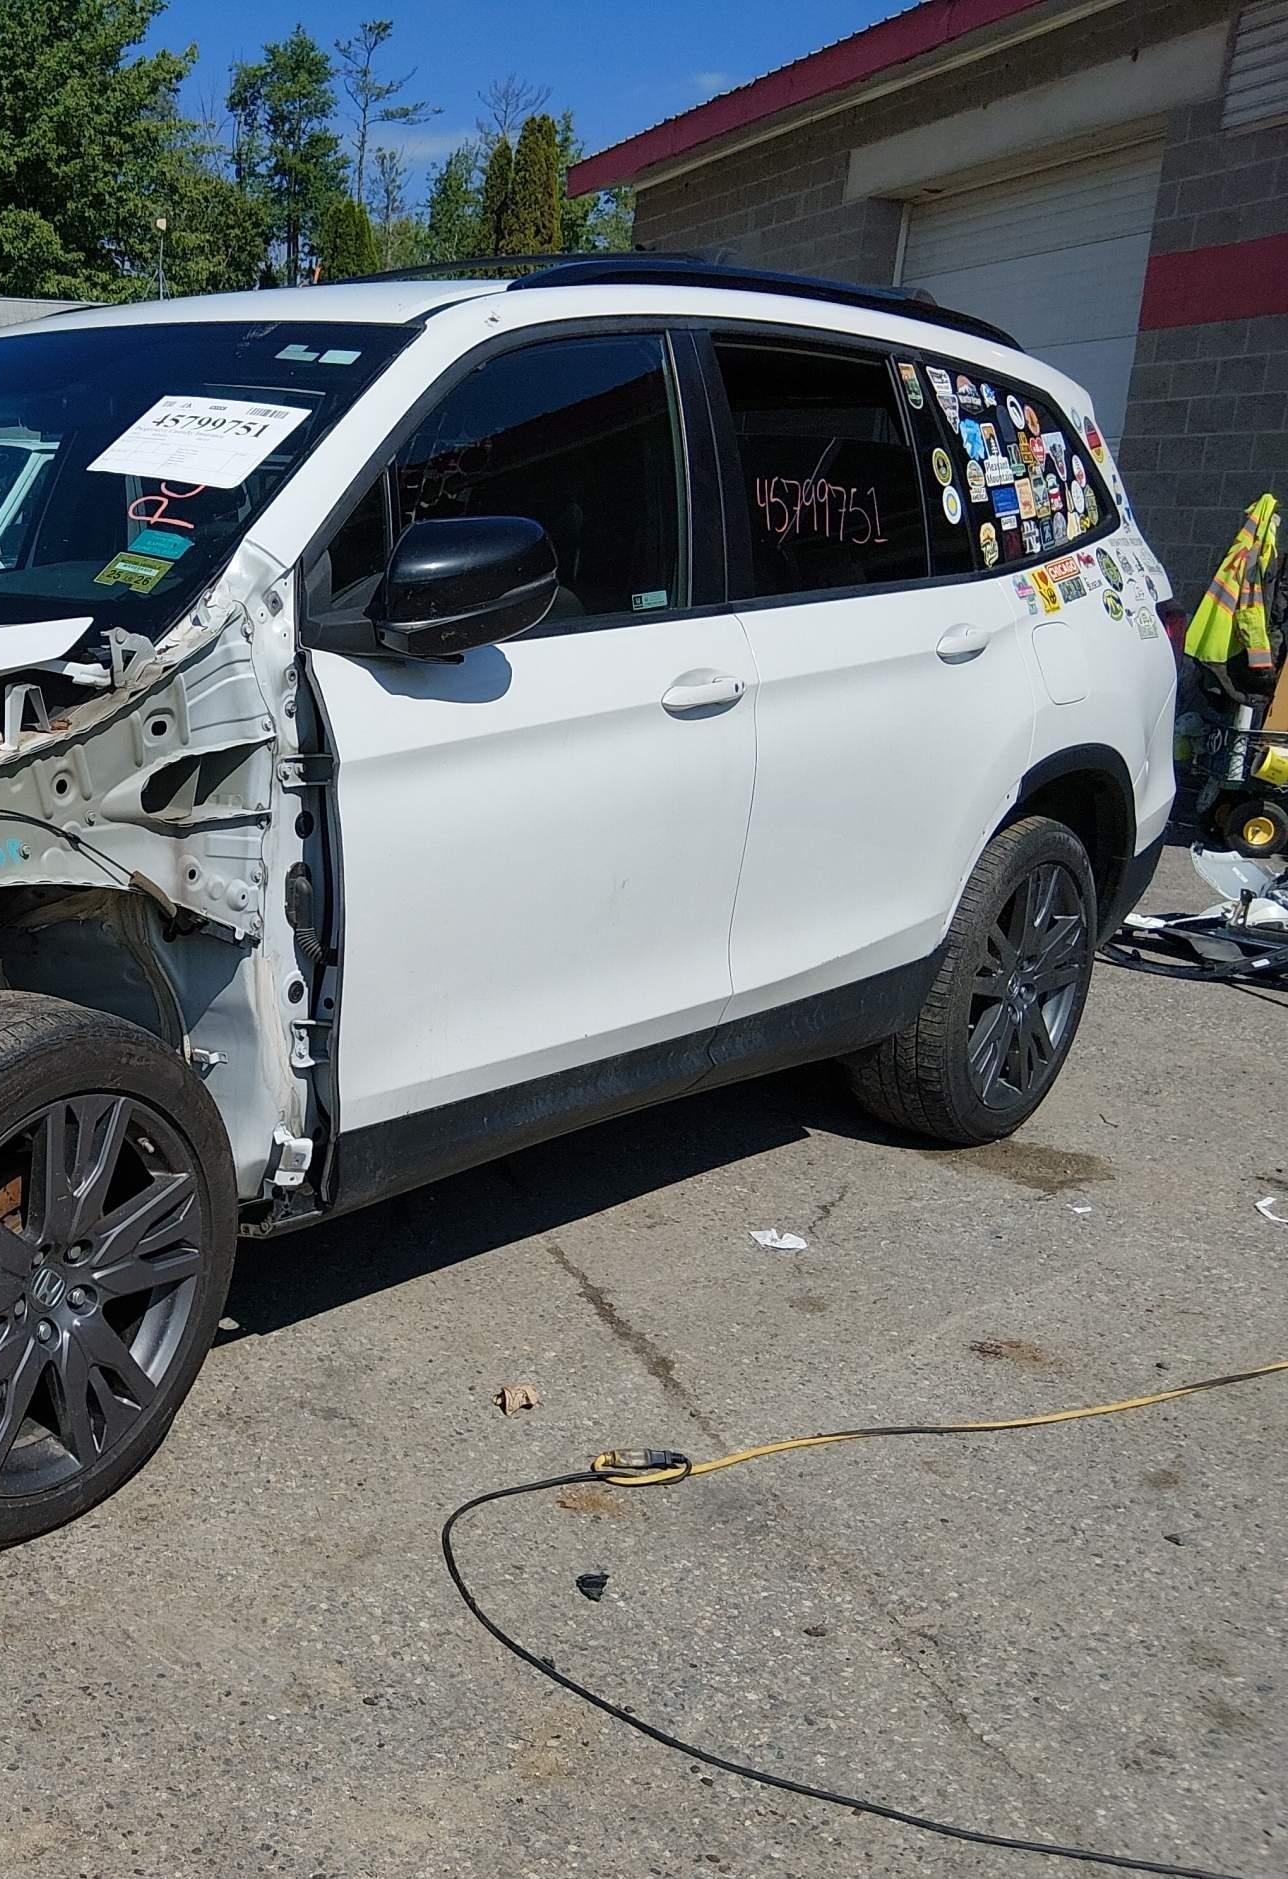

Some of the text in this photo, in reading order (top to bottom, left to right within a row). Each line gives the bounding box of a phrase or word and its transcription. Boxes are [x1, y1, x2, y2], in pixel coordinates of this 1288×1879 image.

[152, 413, 270, 438] 45799751
[756, 477, 888, 544] 45799751
[106, 569, 123, 579] 25
[134, 575, 152, 586] 26
[1048, 560, 1077, 578] CHICAGO
